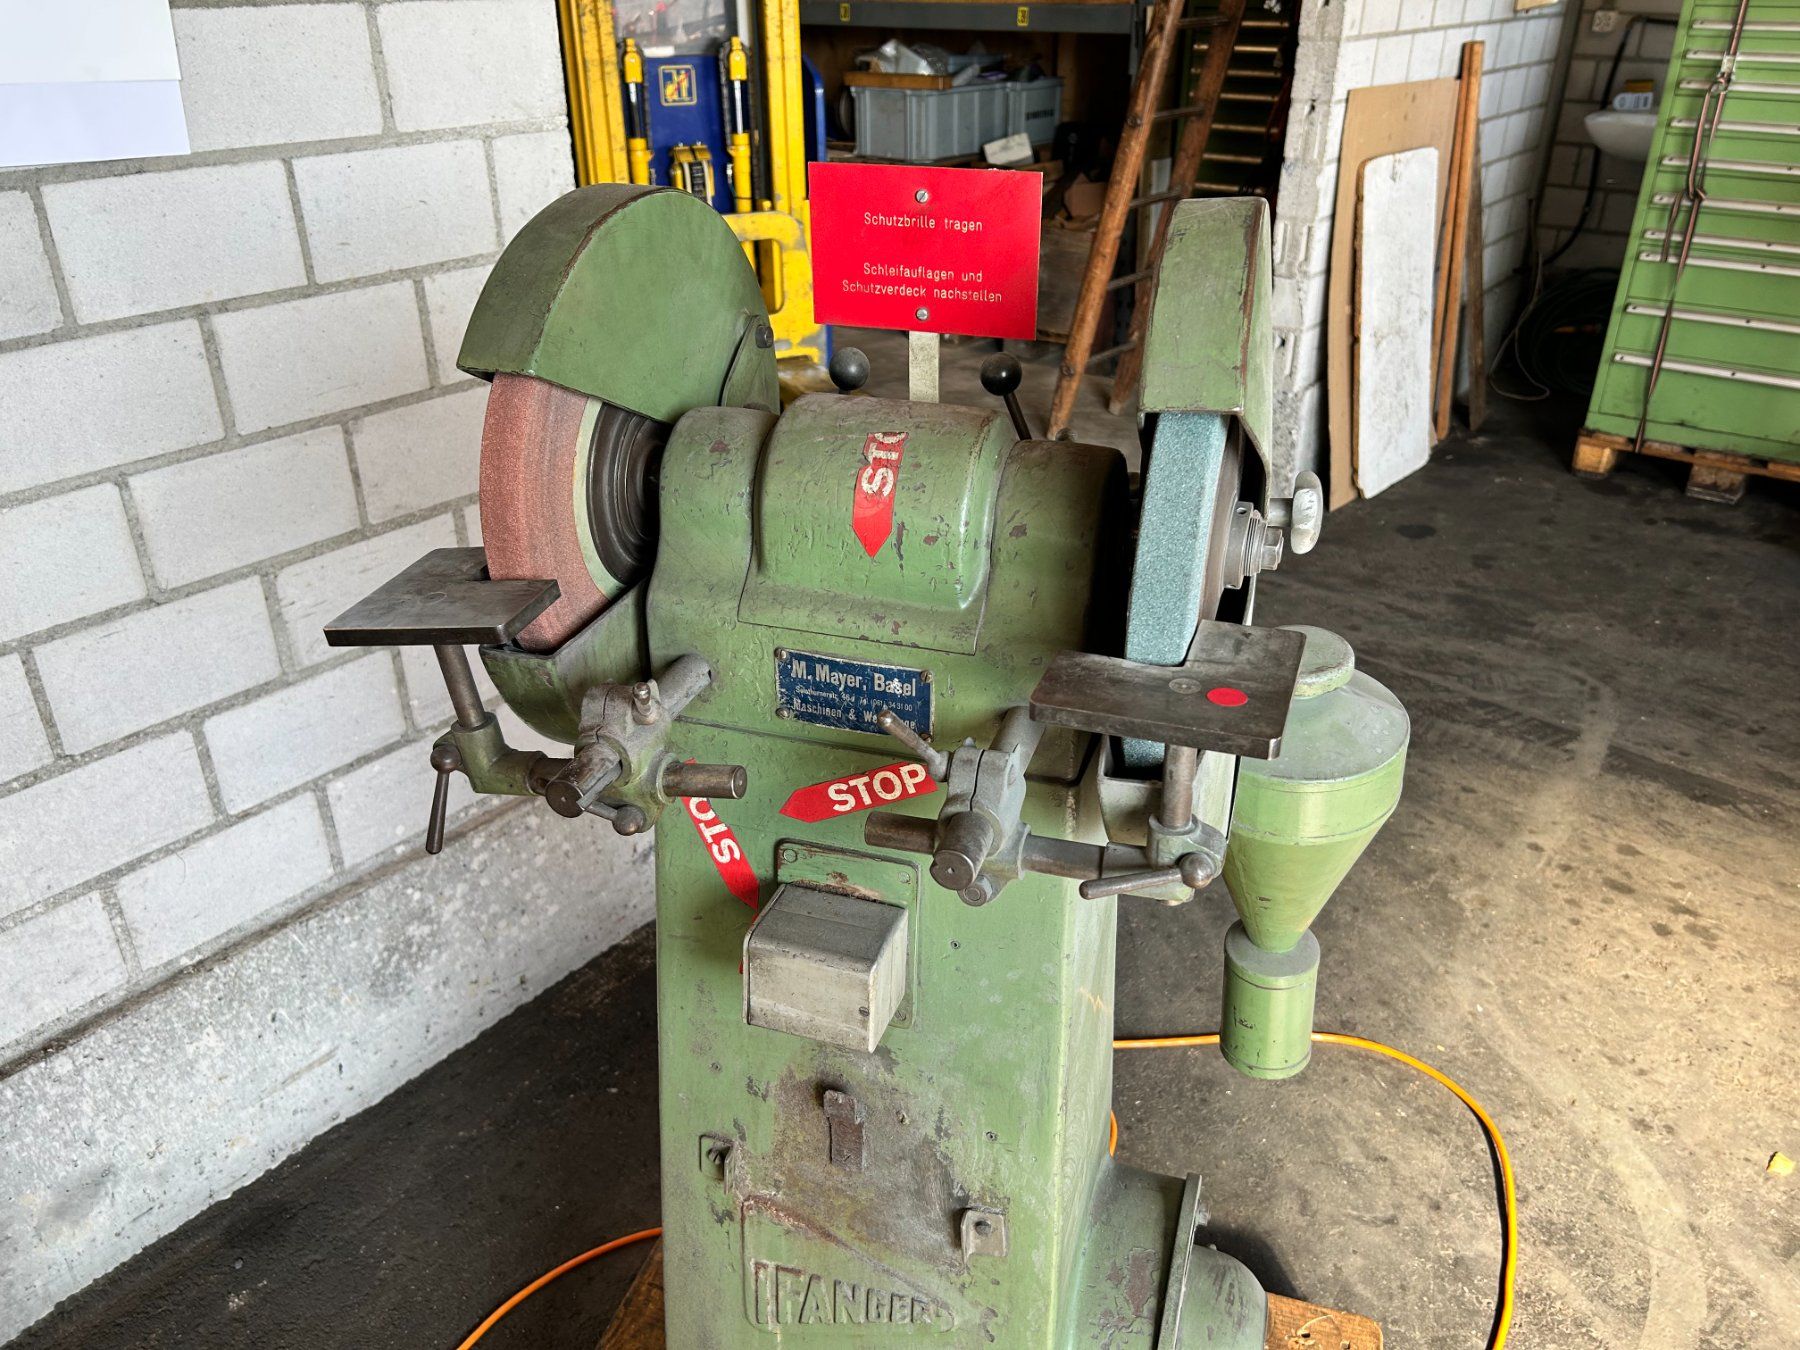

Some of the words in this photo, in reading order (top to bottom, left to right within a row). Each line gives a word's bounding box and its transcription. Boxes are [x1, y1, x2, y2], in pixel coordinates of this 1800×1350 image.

[864, 212, 936, 229] Schutzbrille
[944, 217, 983, 233] tragen
[863, 262, 955, 282] Schleifauflagen
[961, 270, 983, 283] und
[842, 279, 927, 297] Schutzverdeck
[933, 287, 1002, 302] nachstellen
[874, 672, 916, 697] Basel
[792, 697, 842, 717] Maschinen
[848, 708, 857, 721] &
[827, 763, 926, 812] STOP
[689, 796, 741, 864] STO
[752, 1259, 933, 1325] IFANGER
